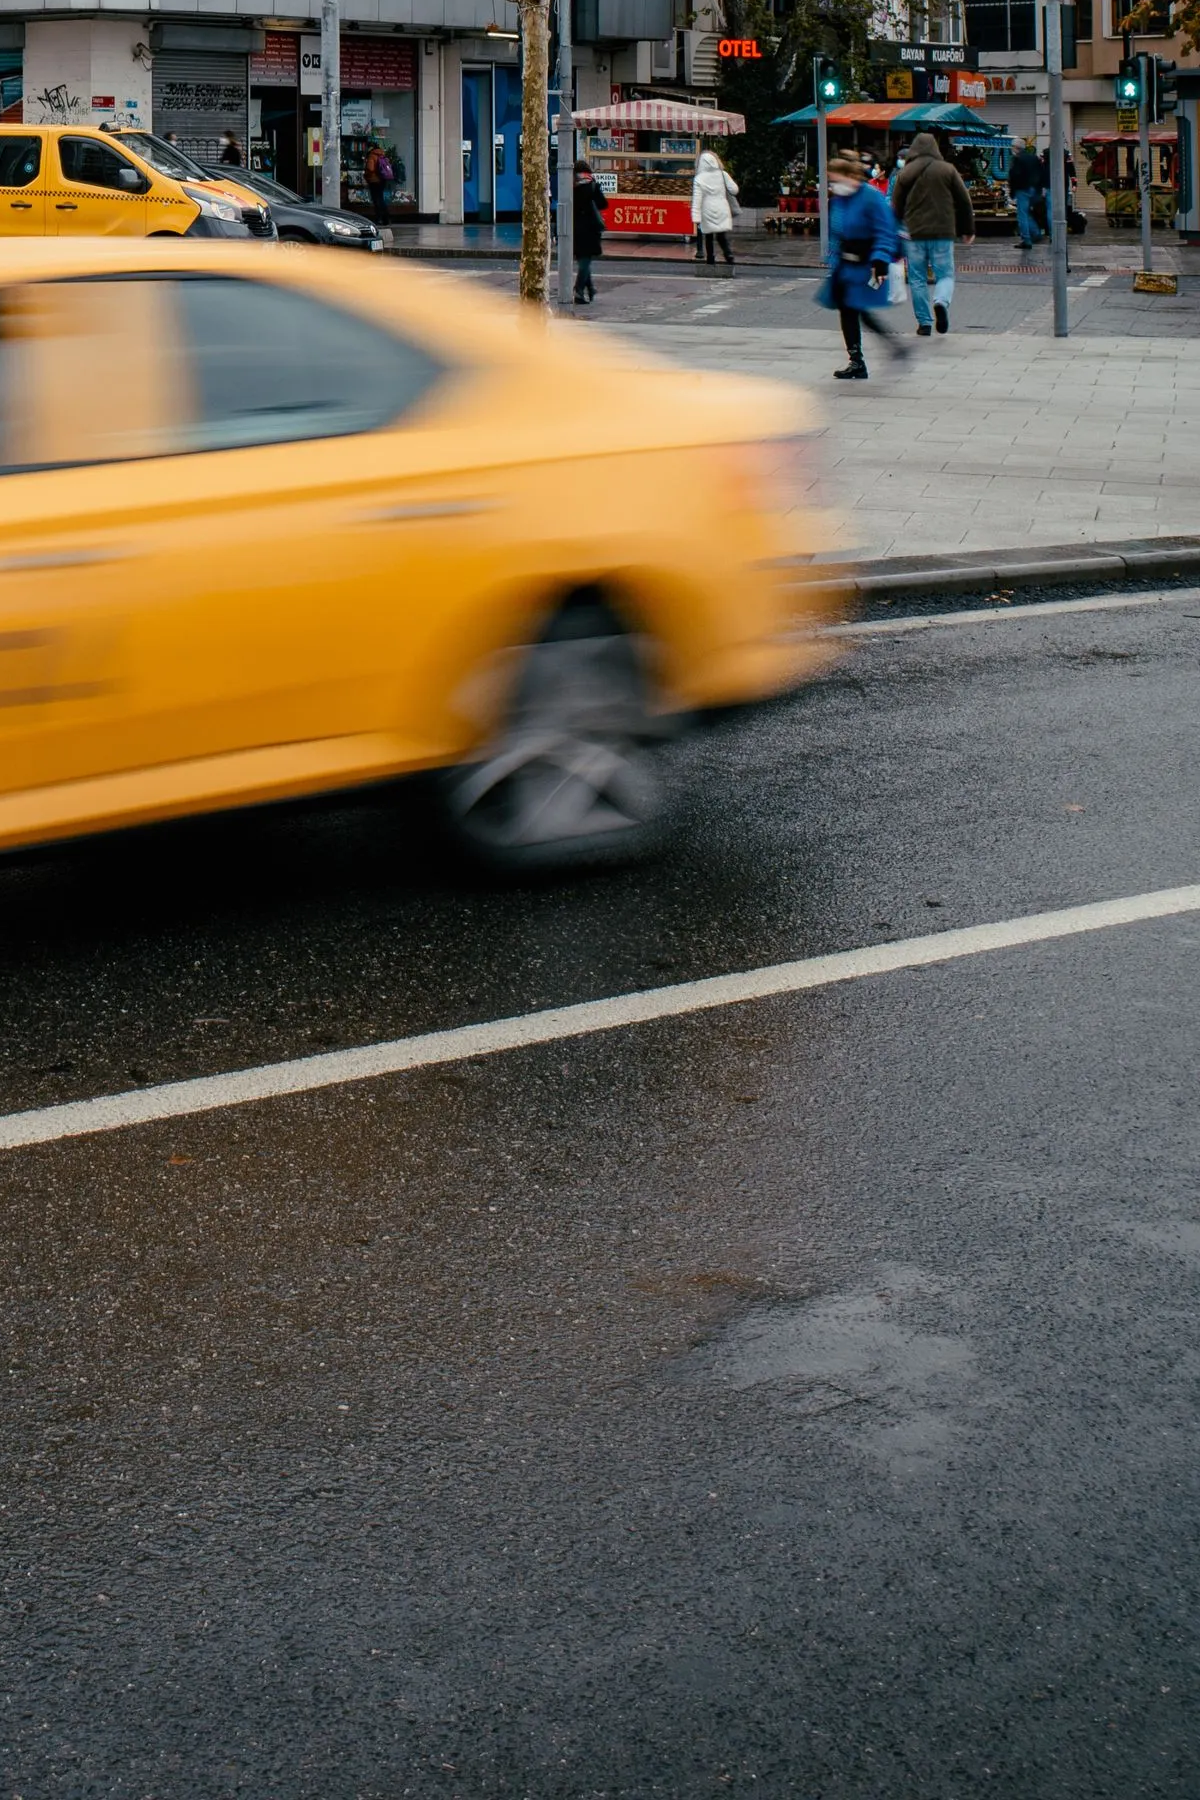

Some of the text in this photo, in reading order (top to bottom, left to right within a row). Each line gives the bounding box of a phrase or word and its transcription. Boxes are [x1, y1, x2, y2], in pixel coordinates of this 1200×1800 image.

[718, 39, 762, 58] OTEL
[901, 48, 965, 63] BAYAN KUAFÖRÜ
[614, 207, 668, 225] SİMİT
